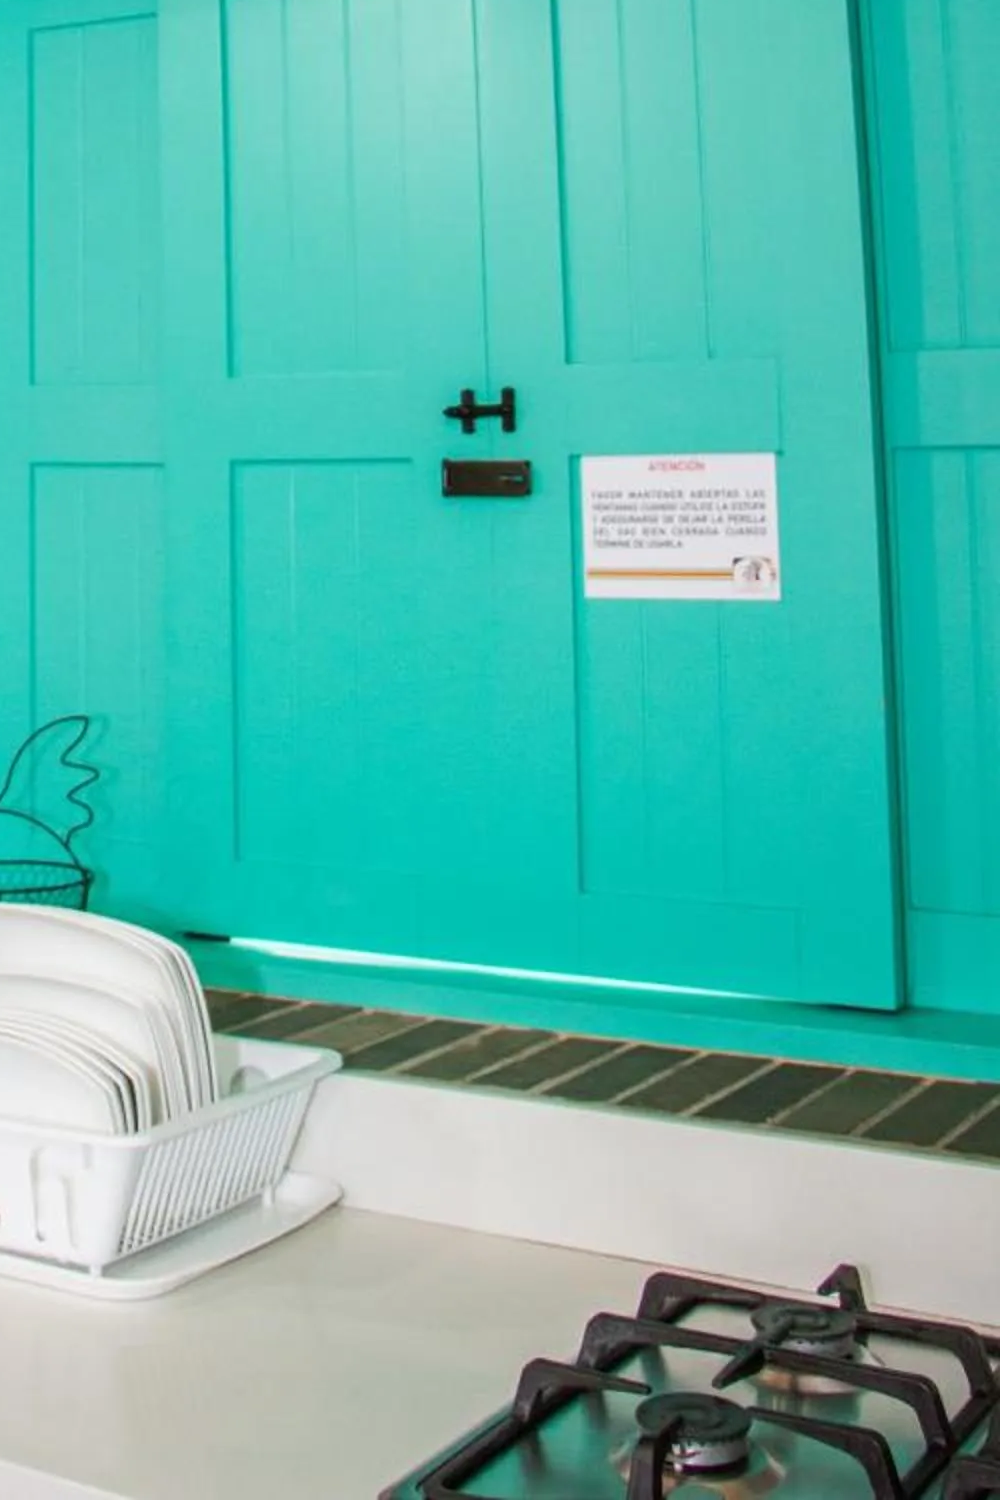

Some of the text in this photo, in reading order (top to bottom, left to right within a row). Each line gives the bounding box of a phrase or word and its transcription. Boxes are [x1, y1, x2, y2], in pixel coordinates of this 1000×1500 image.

[628, 490, 683, 499] MANTENER
[689, 489, 739, 498] ABIERTAS
[746, 489, 766, 498] LAS
[716, 502, 728, 511] LA
[678, 514, 707, 523] DEJAR
[711, 514, 723, 523] LA
[728, 514, 767, 523] PERILLA
[643, 527, 666, 536] BIEN
[671, 527, 720, 536] CERRADA
[725, 526, 767, 535] CUANDO
